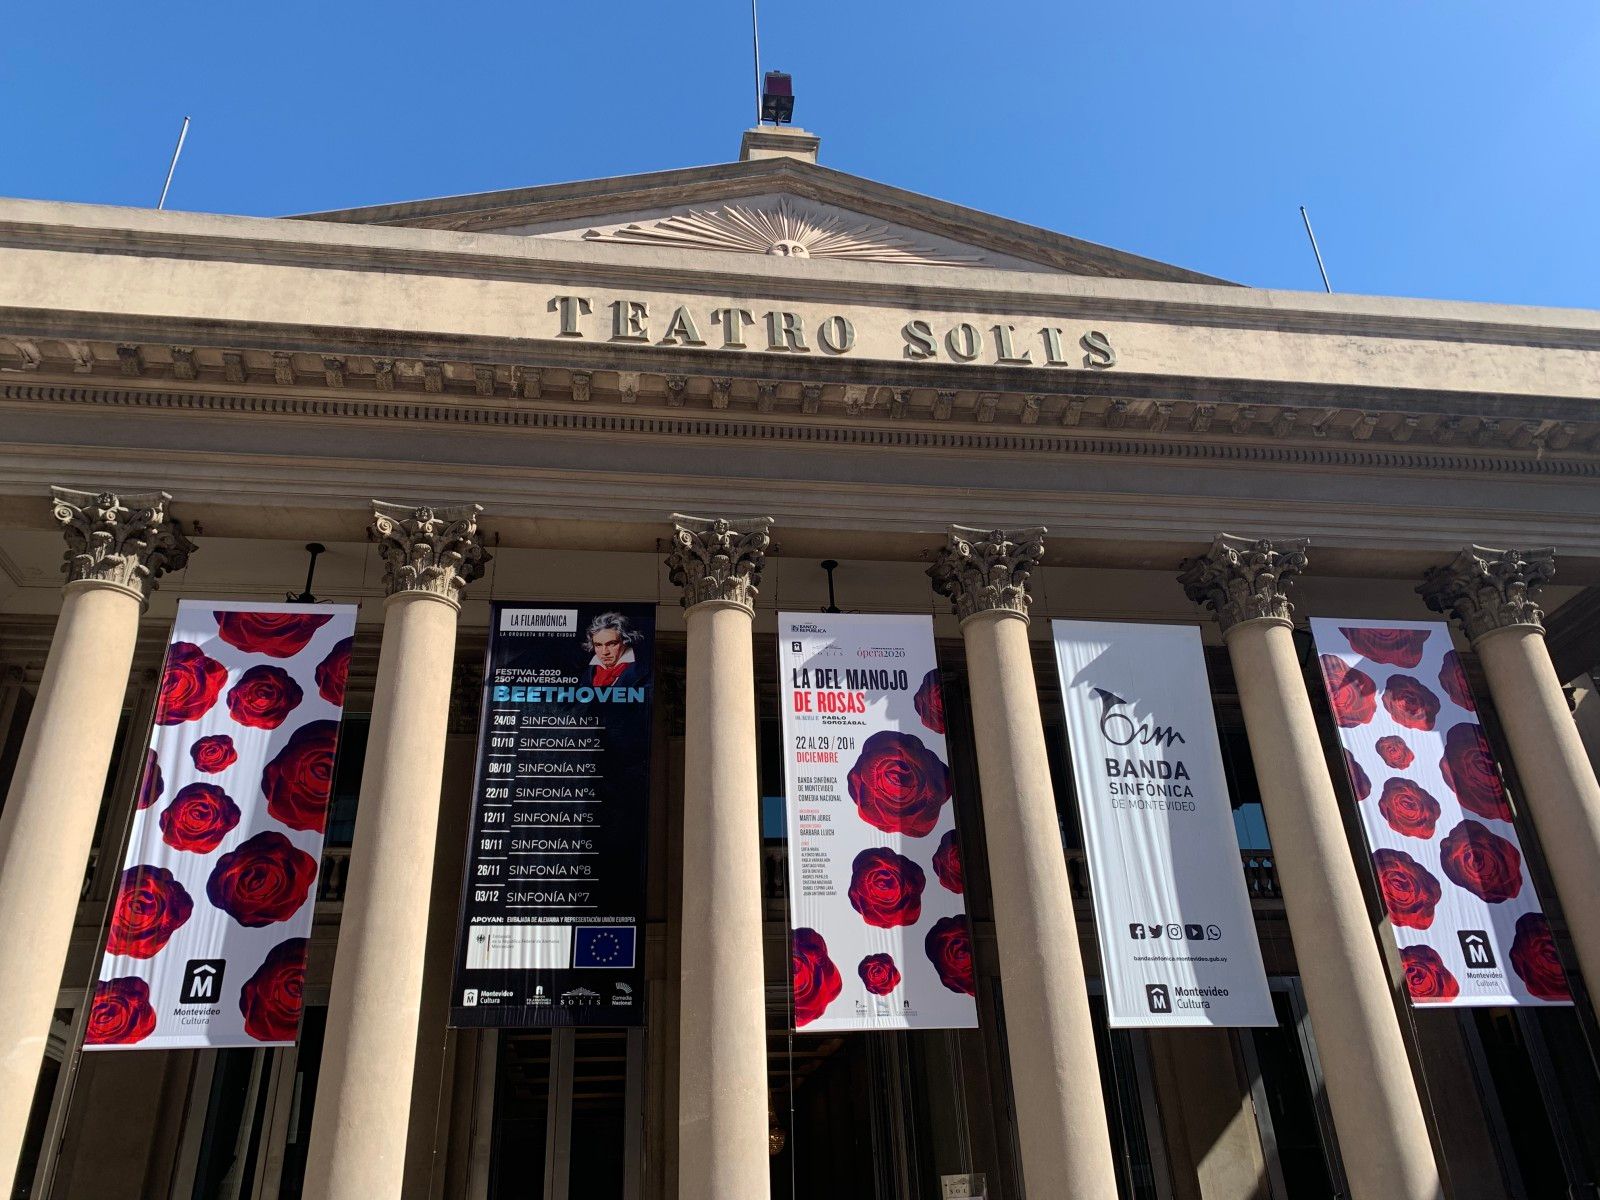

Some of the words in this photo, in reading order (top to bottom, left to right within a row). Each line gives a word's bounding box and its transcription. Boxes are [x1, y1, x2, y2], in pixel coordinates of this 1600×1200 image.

[548, 295, 858, 354] TEATRO
[902, 319, 1118, 369] SOLIS
[510, 614, 519, 627] LA
[520, 612, 567, 627] FILARMÓNICA
[495, 668, 538, 676] FESTIVAL
[516, 676, 579, 684] ANIVERSARIO
[792, 668, 811, 689] LA
[815, 668, 842, 690] DEL
[846, 669, 909, 691] MANOJO
[492, 685, 646, 704] BEETHOVEN
[794, 691, 812, 713] DE
[817, 691, 866, 714] ROSAS
[494, 715, 516, 726] 24/09
[522, 714, 577, 726] SINFONÍA
[491, 737, 514, 748] 01/10
[520, 737, 576, 748] SINFONÍA
[795, 736, 806, 750] 22
[808, 736, 817, 750] AL
[818, 736, 829, 750] 29
[837, 736, 848, 750] 20
[849, 736, 855, 750] H
[796, 751, 839, 763] DICIEMBRE
[488, 762, 512, 773] 08/10
[517, 762, 574, 773] SINFONÍA
[1105, 758, 1191, 781] BANDA
[485, 787, 509, 798] 22/10
[515, 787, 572, 798] SINFONÍA
[1109, 781, 1194, 798] SINFÓNICA
[1111, 799, 1126, 809] DE
[1129, 799, 1196, 812] MONTEVIDEO
[484, 812, 505, 823] 12/11
[513, 811, 571, 823] SINFONÍA
[480, 839, 503, 850] 19/11
[511, 838, 569, 850] SINFONÍA
[477, 864, 500, 876] 26/11
[509, 864, 567, 875] SINFONÍA
[475, 890, 499, 902] 03/12
[506, 891, 565, 902] SINFONÍA
[1466, 971, 1503, 979] Montevideo
[1175, 986, 1229, 997] Montevideo
[1177, 999, 1210, 1009] Cultura
[173, 1008, 221, 1016] Montevideo
[181, 1017, 210, 1025] Cultura
